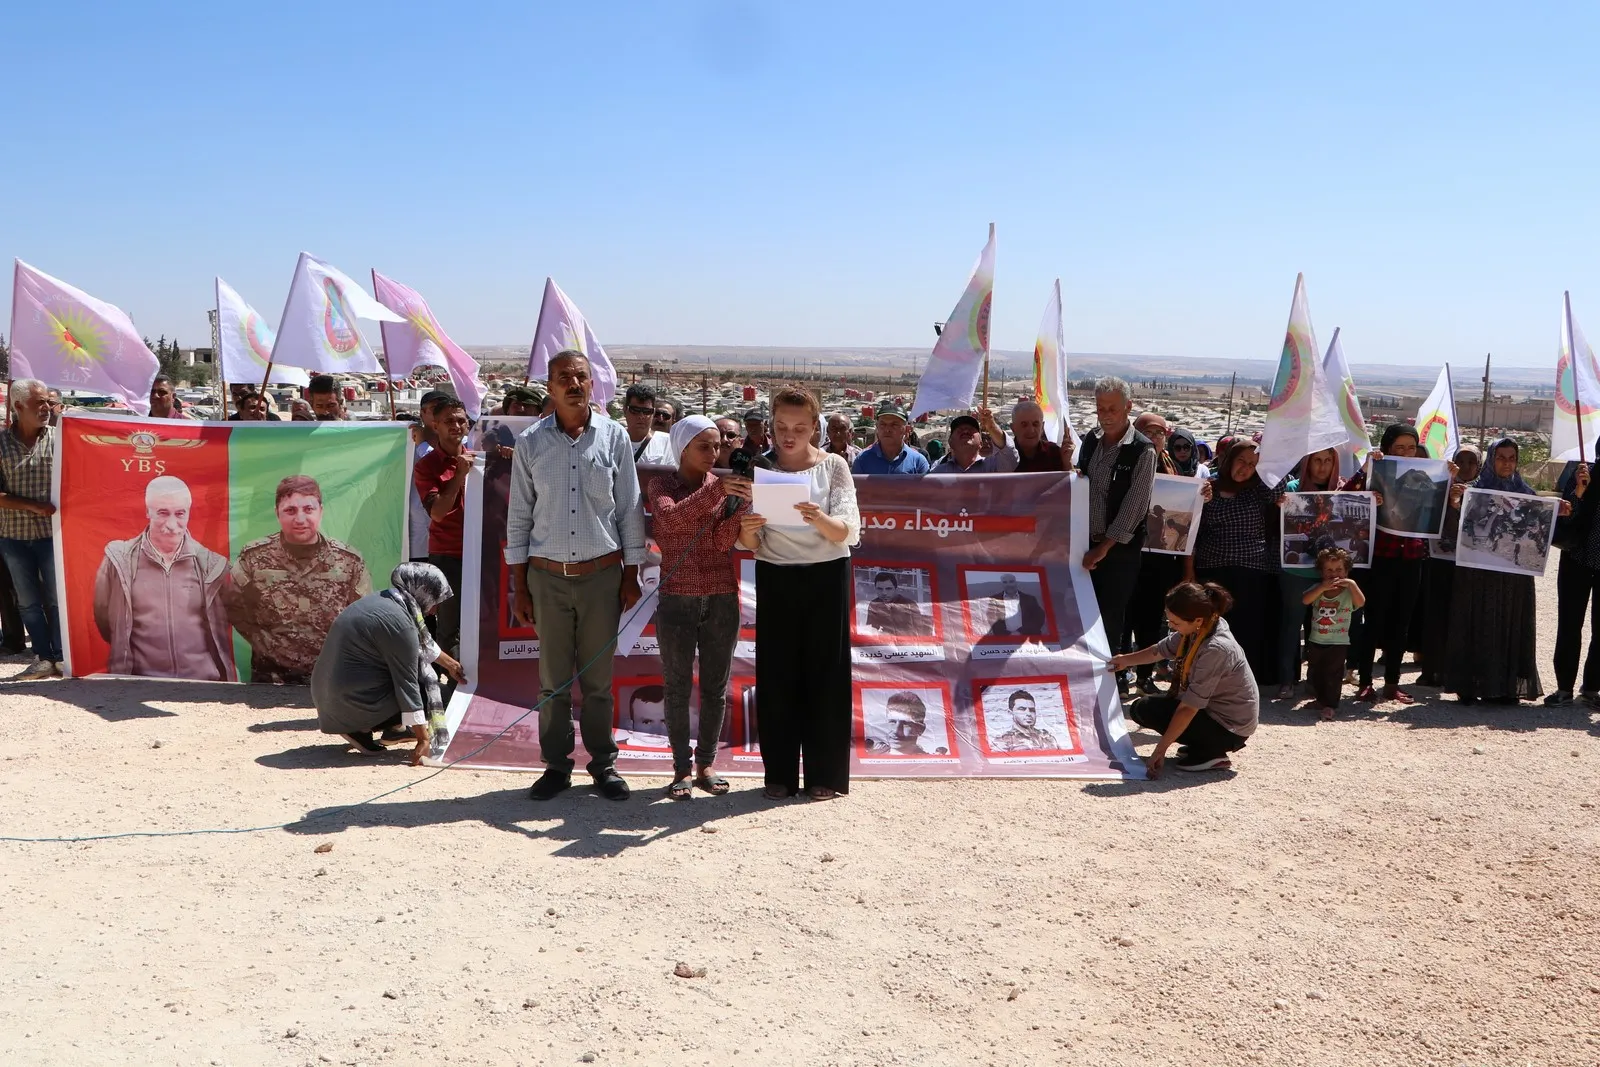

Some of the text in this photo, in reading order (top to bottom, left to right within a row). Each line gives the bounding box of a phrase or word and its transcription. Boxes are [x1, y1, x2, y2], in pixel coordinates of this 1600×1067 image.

[121, 459, 166, 476] YBŞ
[860, 508, 974, 538] شهداء مدي
[504, 644, 526, 655] الياس
[859, 649, 938, 660] الشهيد عيسى خديدة
[980, 648, 1001, 656] حسن
